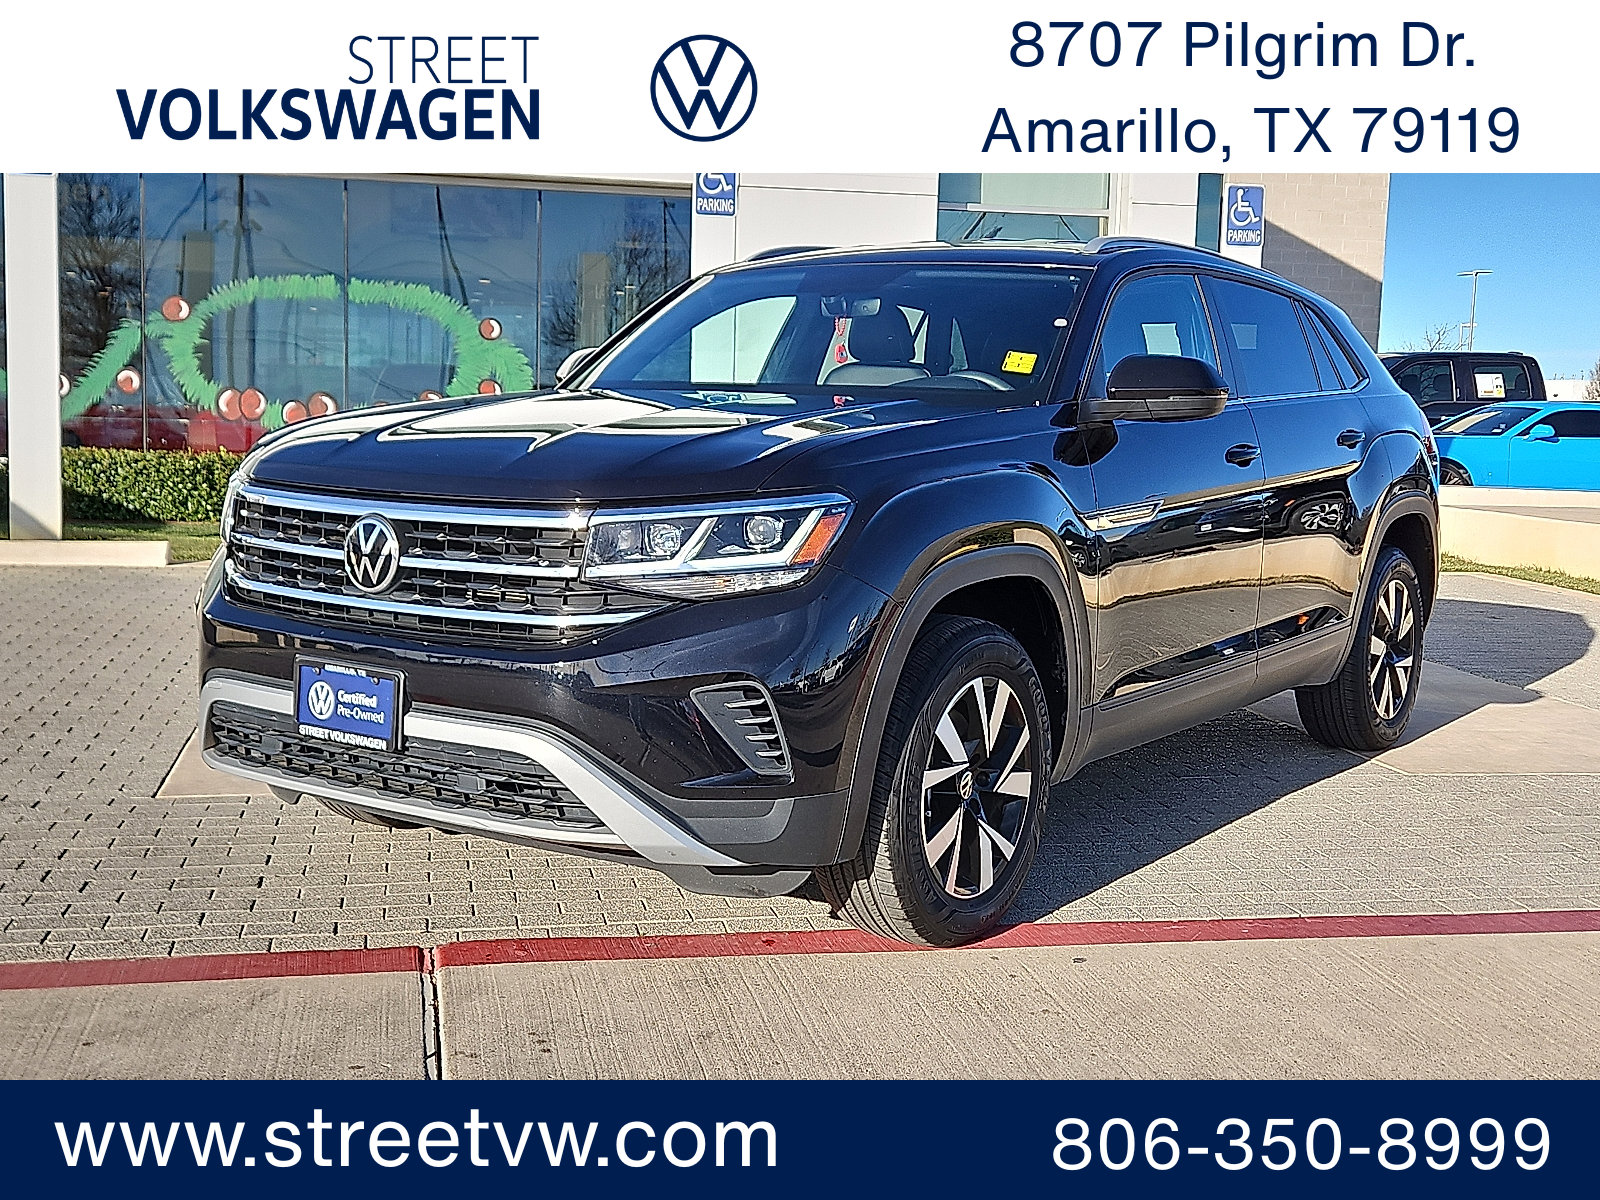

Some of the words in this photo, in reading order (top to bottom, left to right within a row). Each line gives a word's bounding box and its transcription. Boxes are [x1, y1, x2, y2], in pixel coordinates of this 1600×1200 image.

[697, 197, 734, 212] PARKING
[1227, 229, 1261, 243] PARKING
[337, 690, 378, 708] Certified
[337, 704, 385, 724] Pre-Owned
[299, 725, 329, 740] STREET
[330, 731, 387, 751] VOLKSWAGEN
